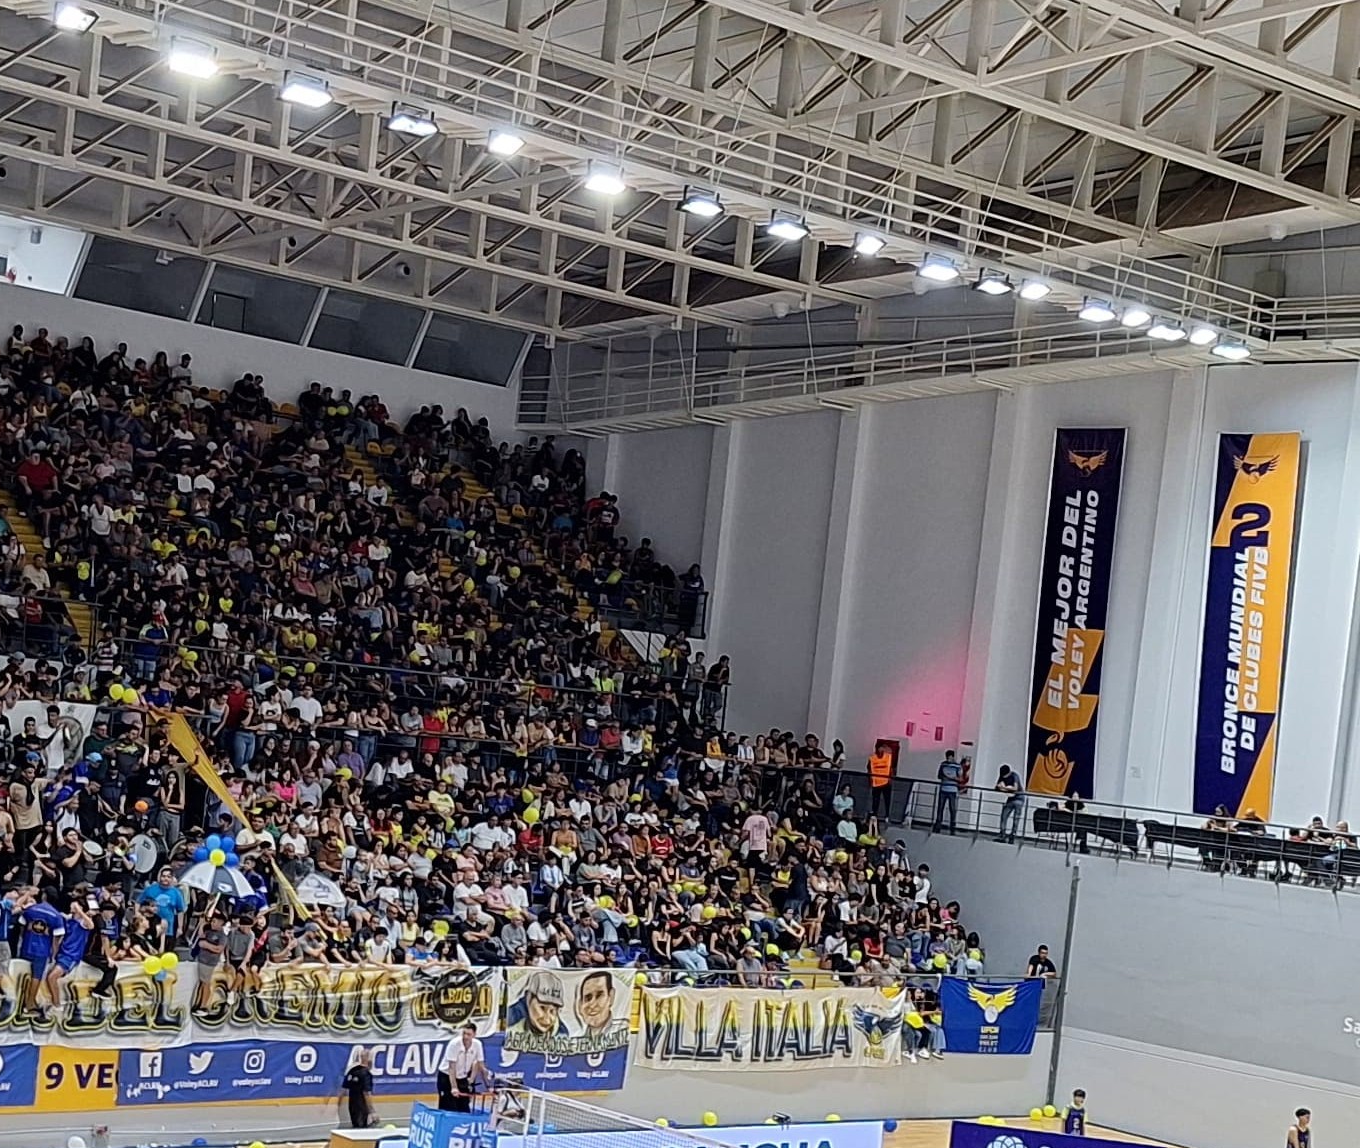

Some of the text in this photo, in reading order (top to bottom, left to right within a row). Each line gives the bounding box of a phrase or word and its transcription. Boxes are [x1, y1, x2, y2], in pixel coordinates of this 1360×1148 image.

[1230, 502, 1271, 548] 2
[1046, 490, 1081, 709] EL MEJOR DEL
[1067, 490, 1099, 710] VOLEY ARGENTINO
[1221, 548, 1250, 774] BRONCE MUNDIAL
[1241, 547, 1269, 751] DE CLUBES FIVB
[45, 1063, 65, 1090] 9
[641, 988, 853, 1062] VILLA ITALIA
[419, 1110, 436, 1132] LVA
